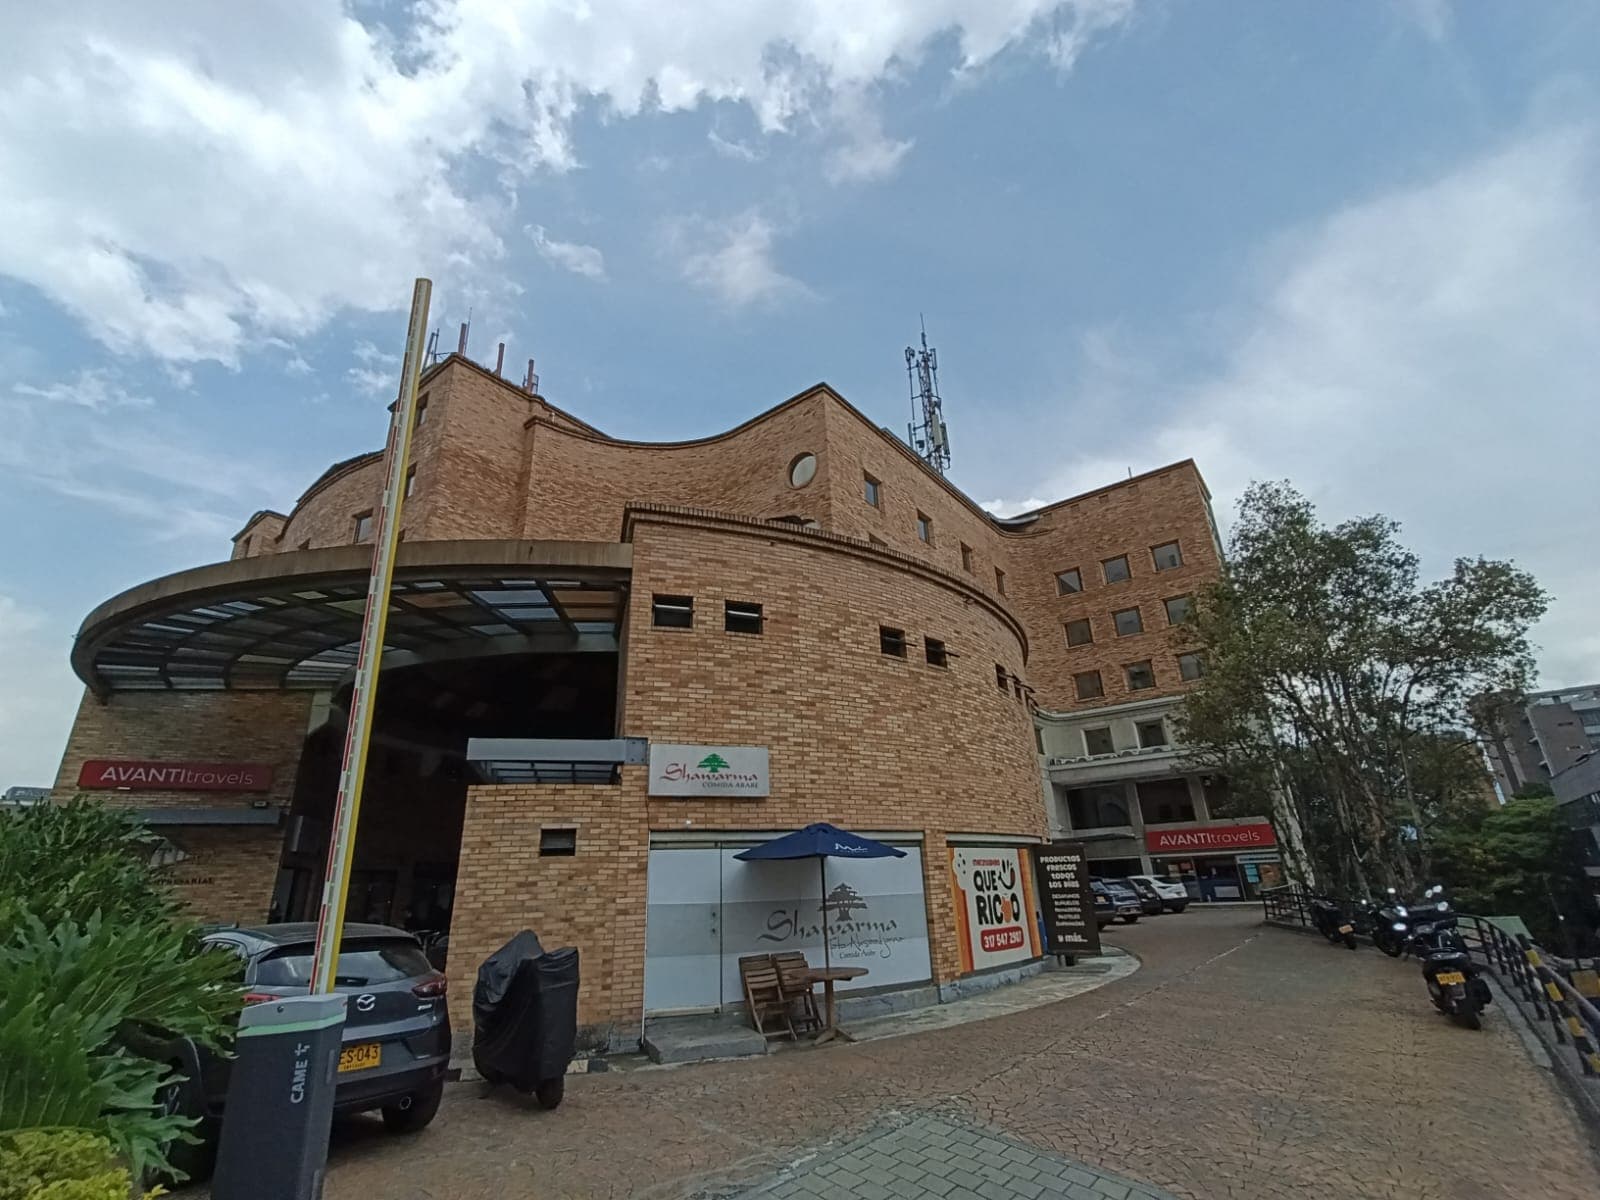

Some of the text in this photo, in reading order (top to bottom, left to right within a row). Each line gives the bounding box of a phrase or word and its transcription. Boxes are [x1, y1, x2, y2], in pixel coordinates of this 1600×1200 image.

[100, 766, 254, 785] AVANTItravels
[660, 763, 758, 782] Shawarma
[1160, 830, 1261, 846] AVANTItravels
[973, 870, 998, 893] QUE
[757, 909, 898, 942] Shawarma
[983, 936, 995, 949] 317
[290, 1059, 308, 1103] CAME
